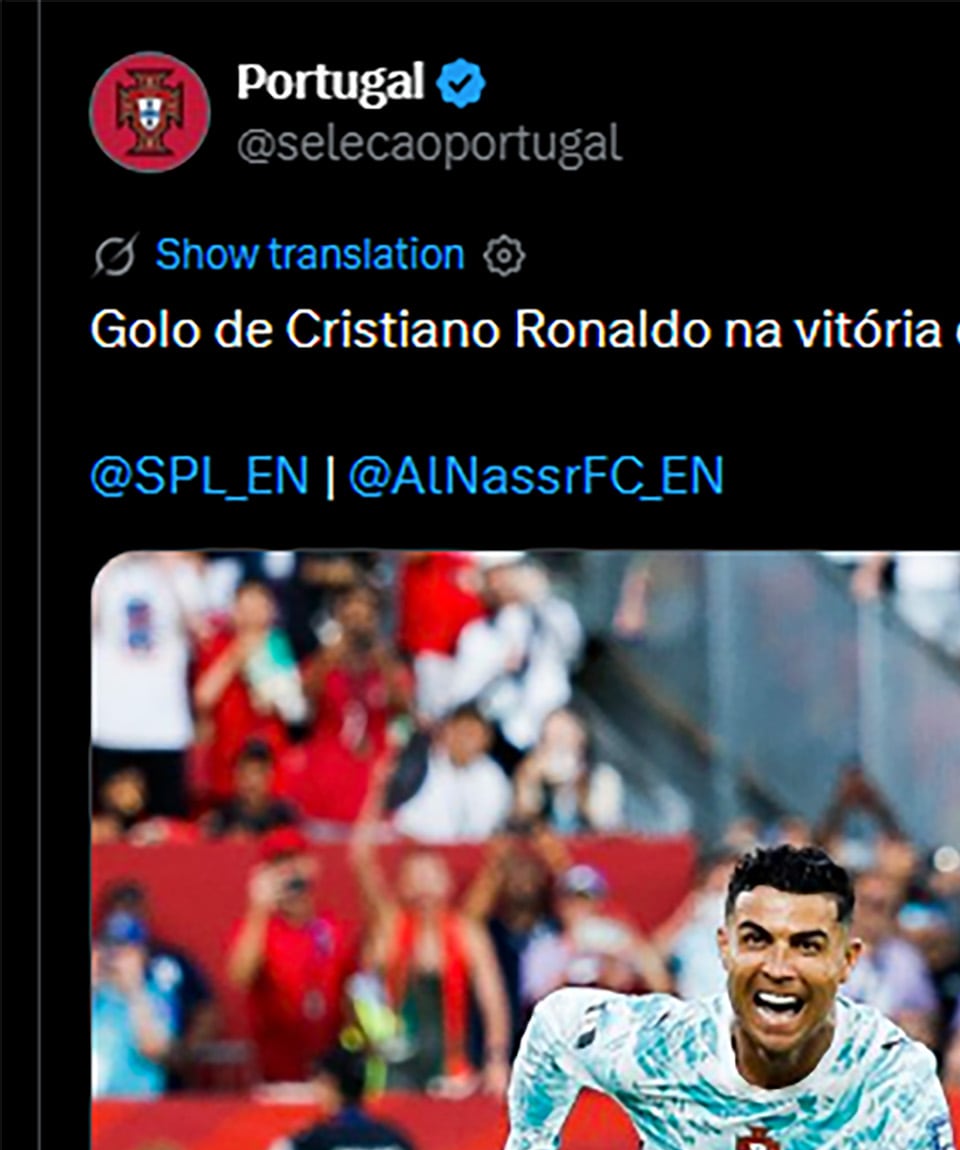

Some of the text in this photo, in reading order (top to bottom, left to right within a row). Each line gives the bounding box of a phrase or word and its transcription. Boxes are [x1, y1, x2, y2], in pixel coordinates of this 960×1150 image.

[237, 60, 425, 109] Portugal
[238, 123, 622, 170] @selecaoportugal
[155, 236, 465, 271] Show translation
[90, 308, 201, 349] Golo
[214, 308, 273, 349] de
[286, 308, 501, 349] Cristiano
[515, 308, 713, 349] Ronaldo
[725, 318, 783, 349] na
[792, 308, 943, 349] vitória
[89, 454, 308, 502] @SPL_EN
[347, 454, 724, 502] @AlNassrFC_EN
